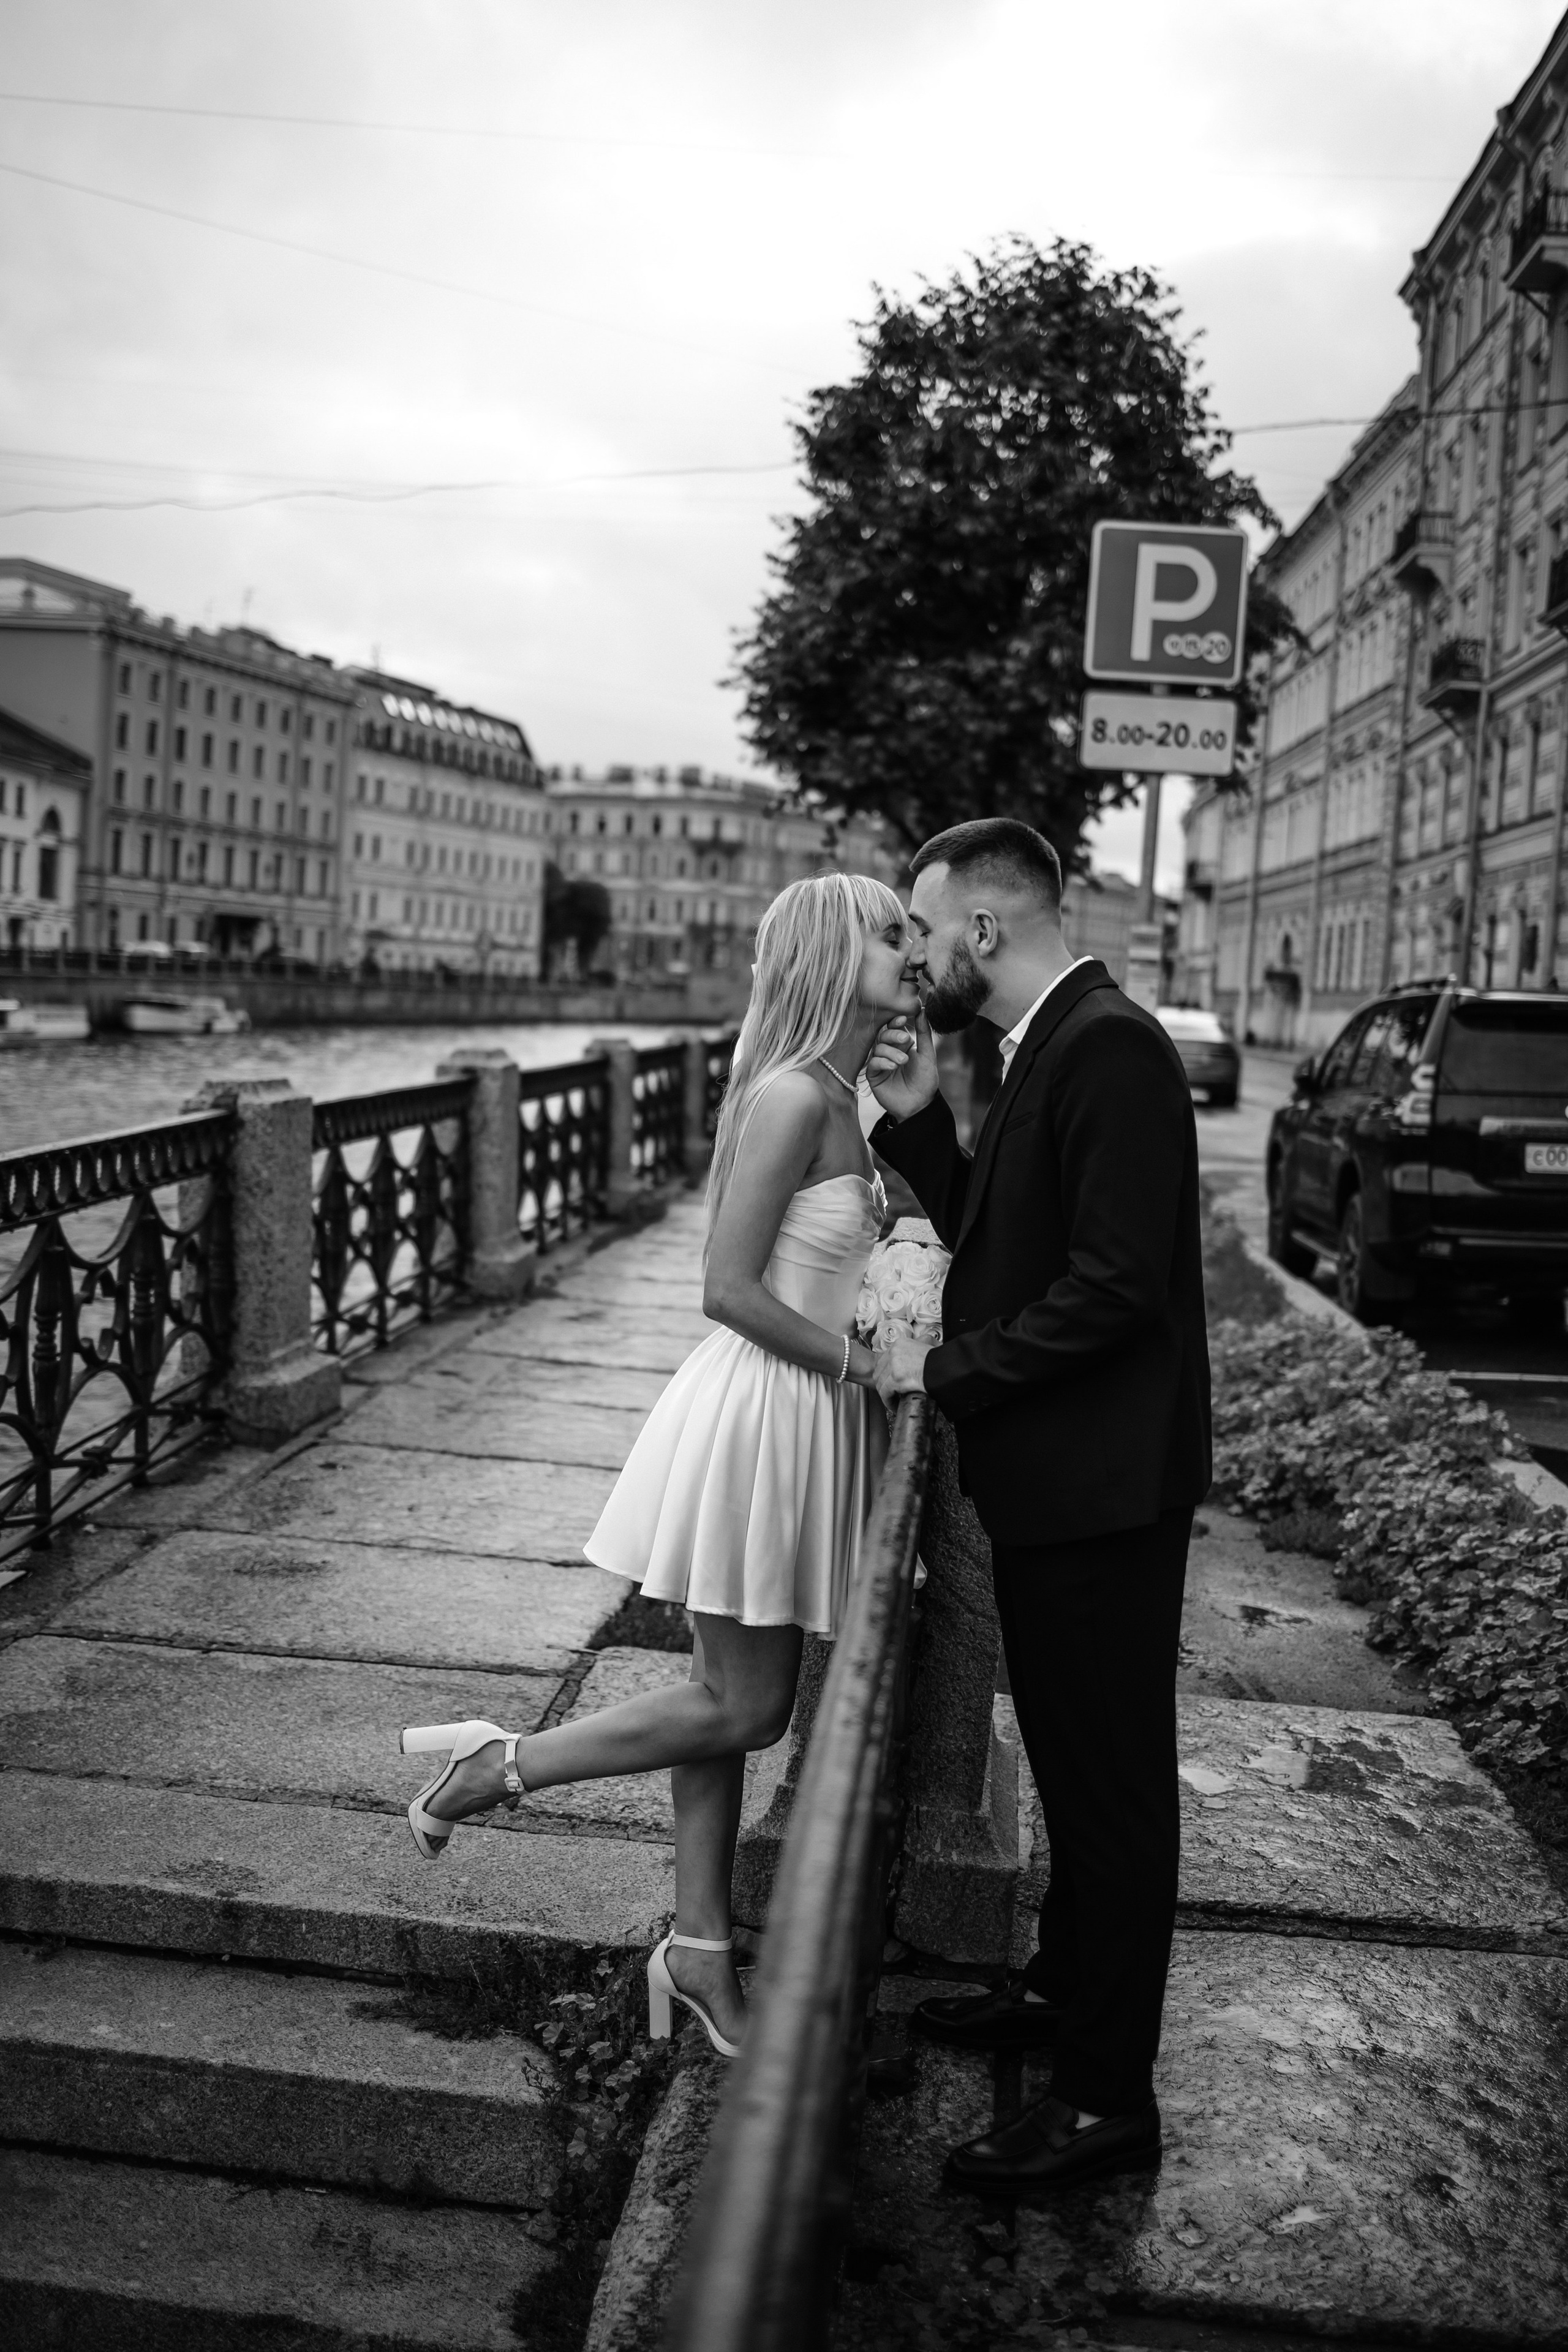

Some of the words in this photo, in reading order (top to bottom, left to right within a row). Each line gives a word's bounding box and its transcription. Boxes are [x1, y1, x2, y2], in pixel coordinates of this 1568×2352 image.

[1130, 543, 1218, 662] P
[1204, 638, 1227, 655] 20
[1091, 717, 1227, 751] 8.00-20.00
